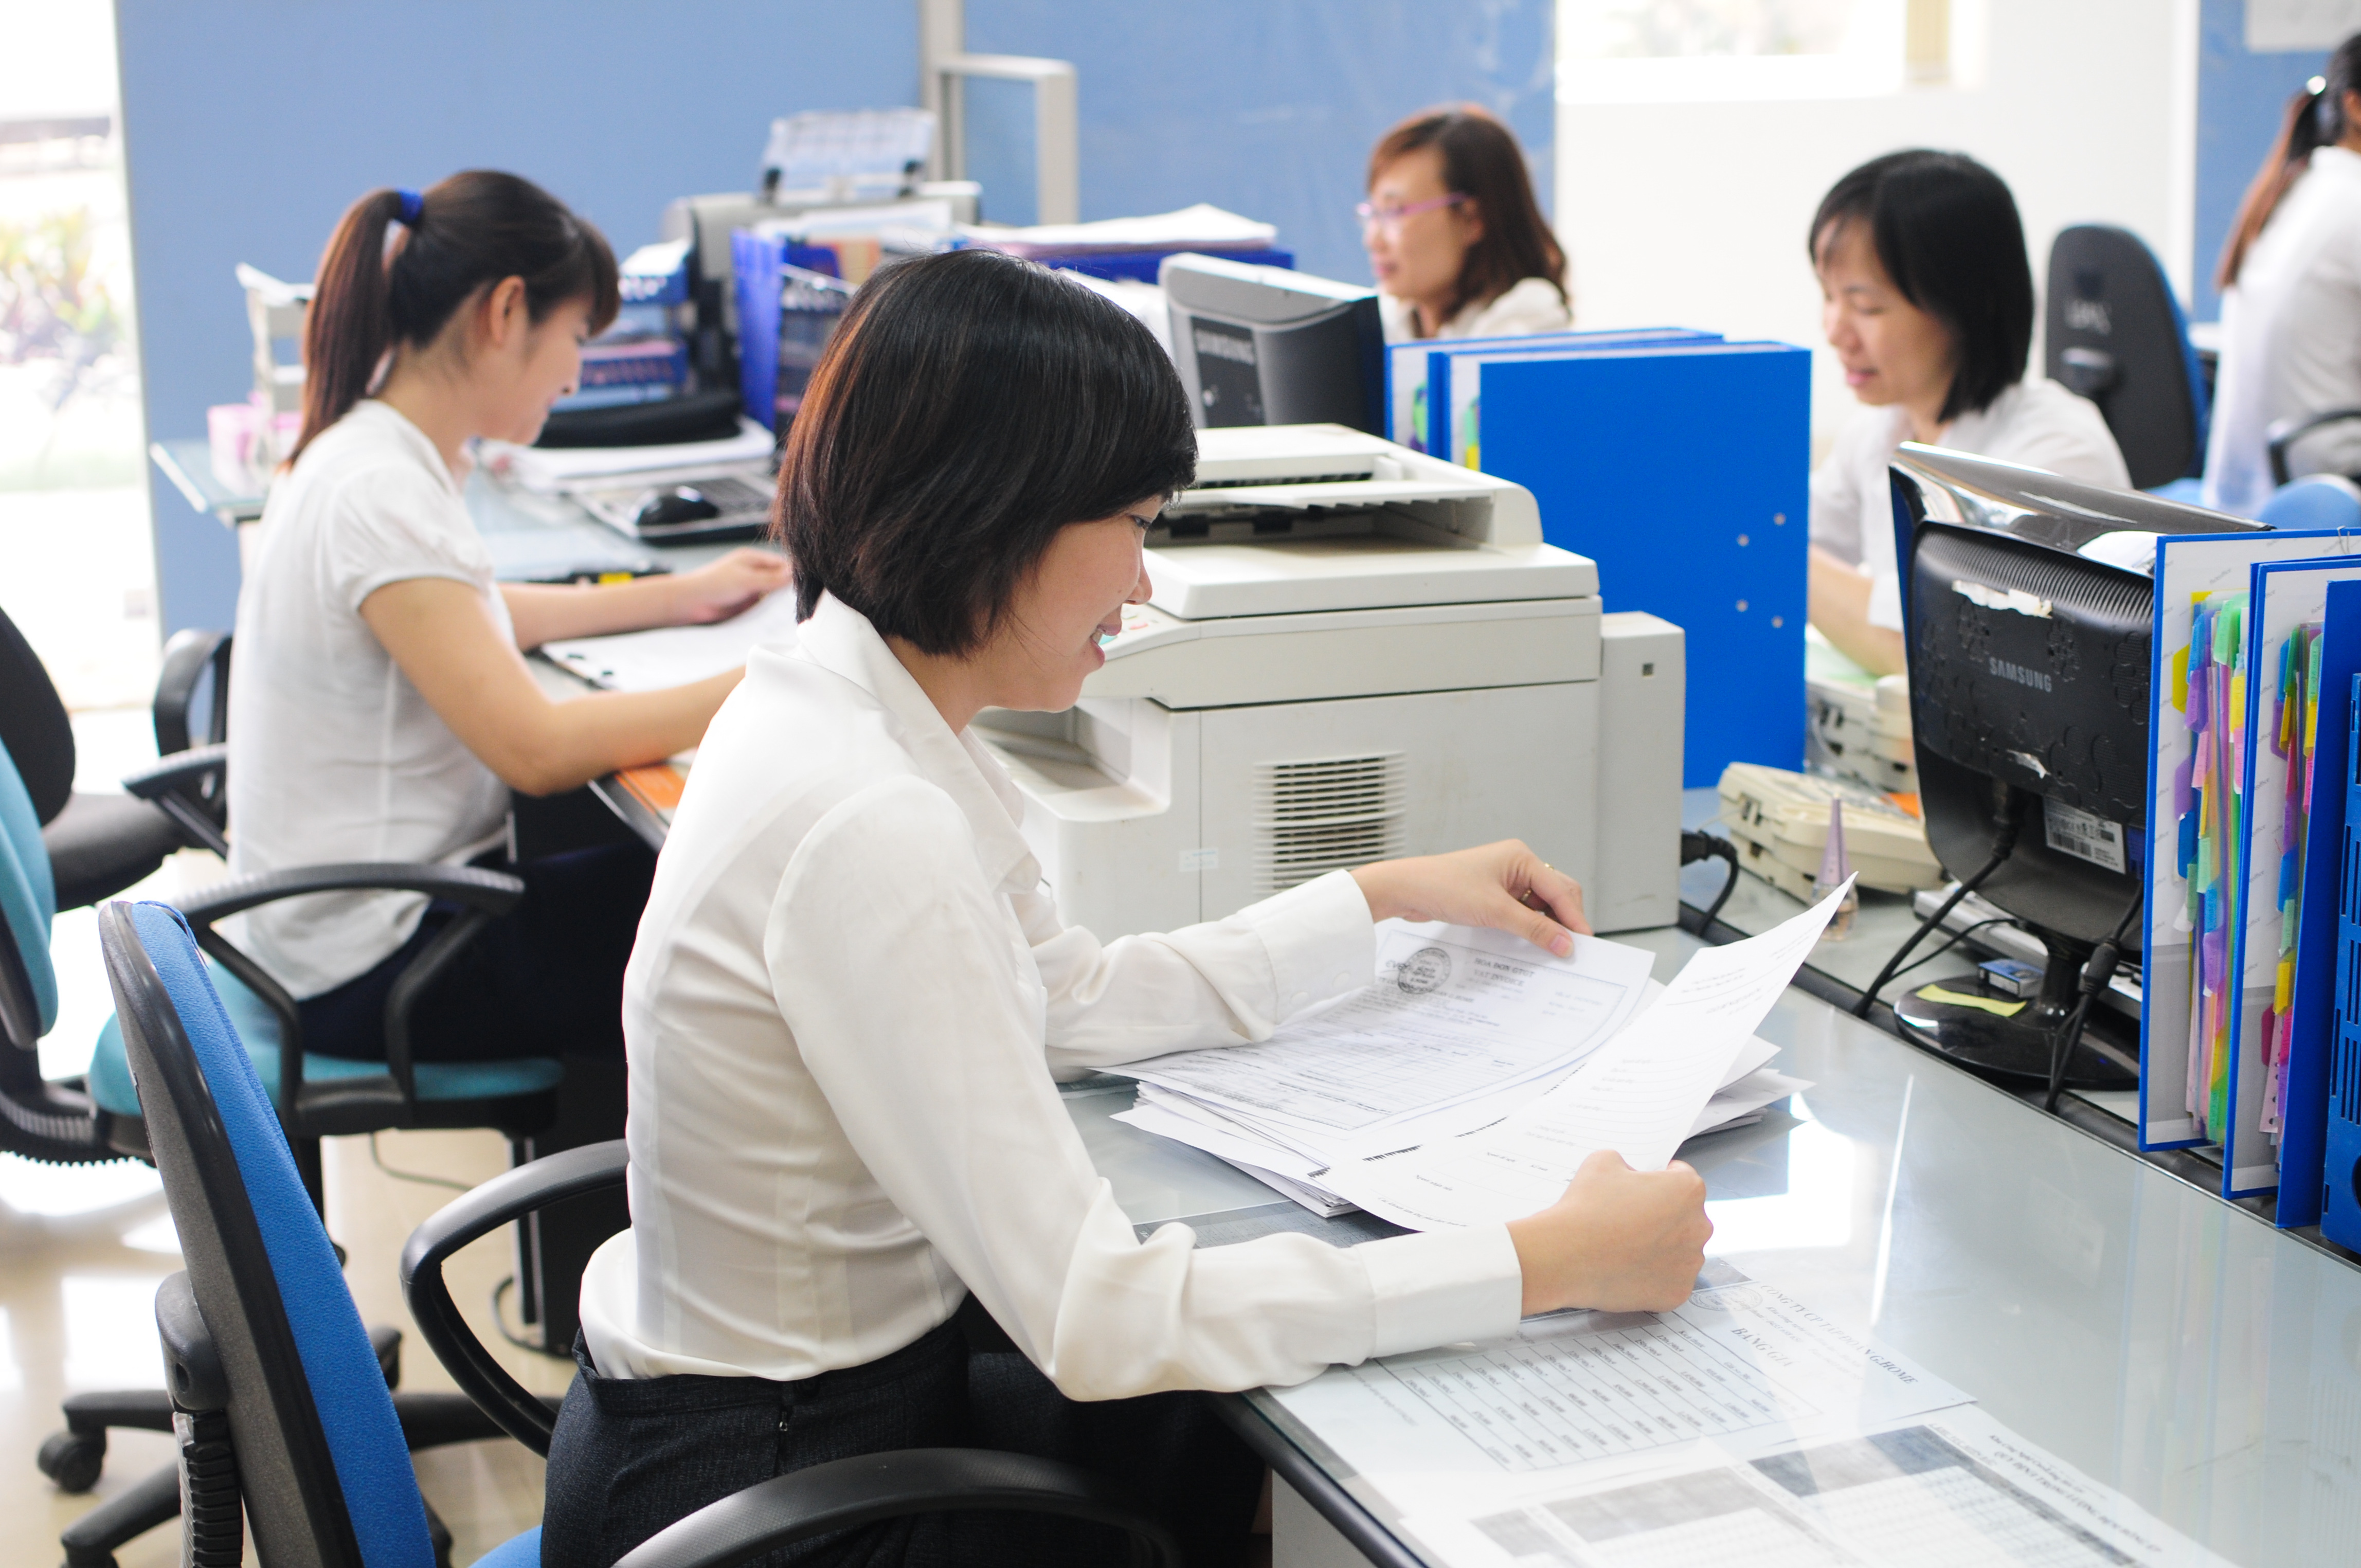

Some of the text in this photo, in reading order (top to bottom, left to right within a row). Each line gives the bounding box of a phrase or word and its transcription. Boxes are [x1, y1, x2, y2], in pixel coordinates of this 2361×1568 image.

[1989, 656, 2052, 692] SAMSUNG
[1789, 1303, 1809, 1312] TY
[1804, 1313, 1823, 1322] CP
[1869, 1355, 1919, 1384] G.HOME
